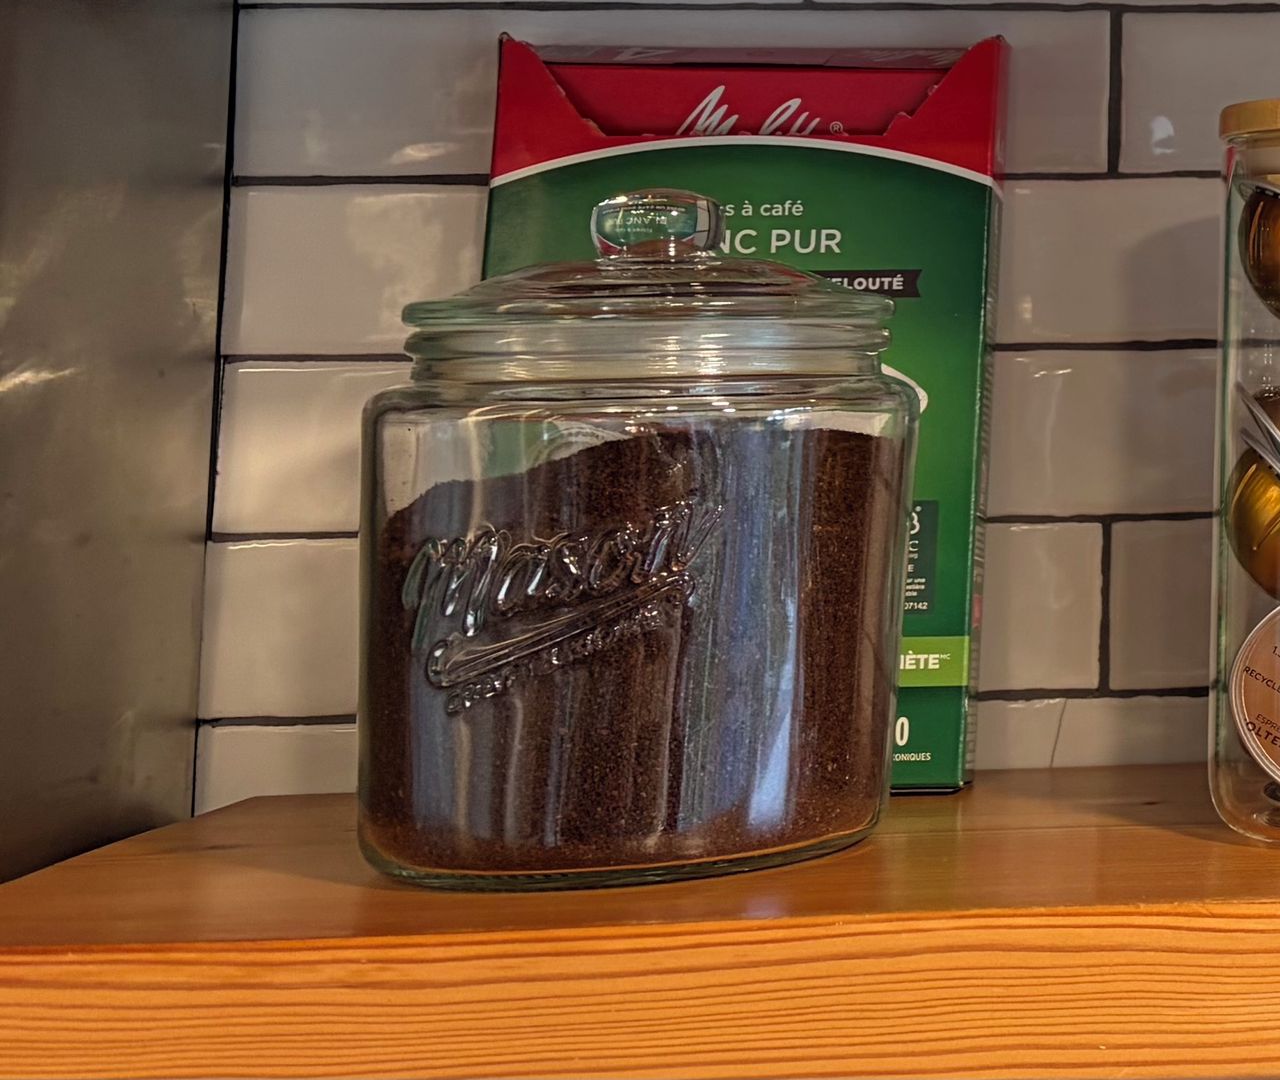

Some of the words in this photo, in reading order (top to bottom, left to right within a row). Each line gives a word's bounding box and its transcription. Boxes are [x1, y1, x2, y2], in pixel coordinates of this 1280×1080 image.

[741, 200, 753, 216] à
[760, 200, 804, 217] café
[719, 228, 758, 254] NC
[769, 228, 842, 254] PUR
[826, 273, 905, 291] LOUTÉ
[900, 650, 940, 670] ÈTE
[895, 716, 910, 746] 0
